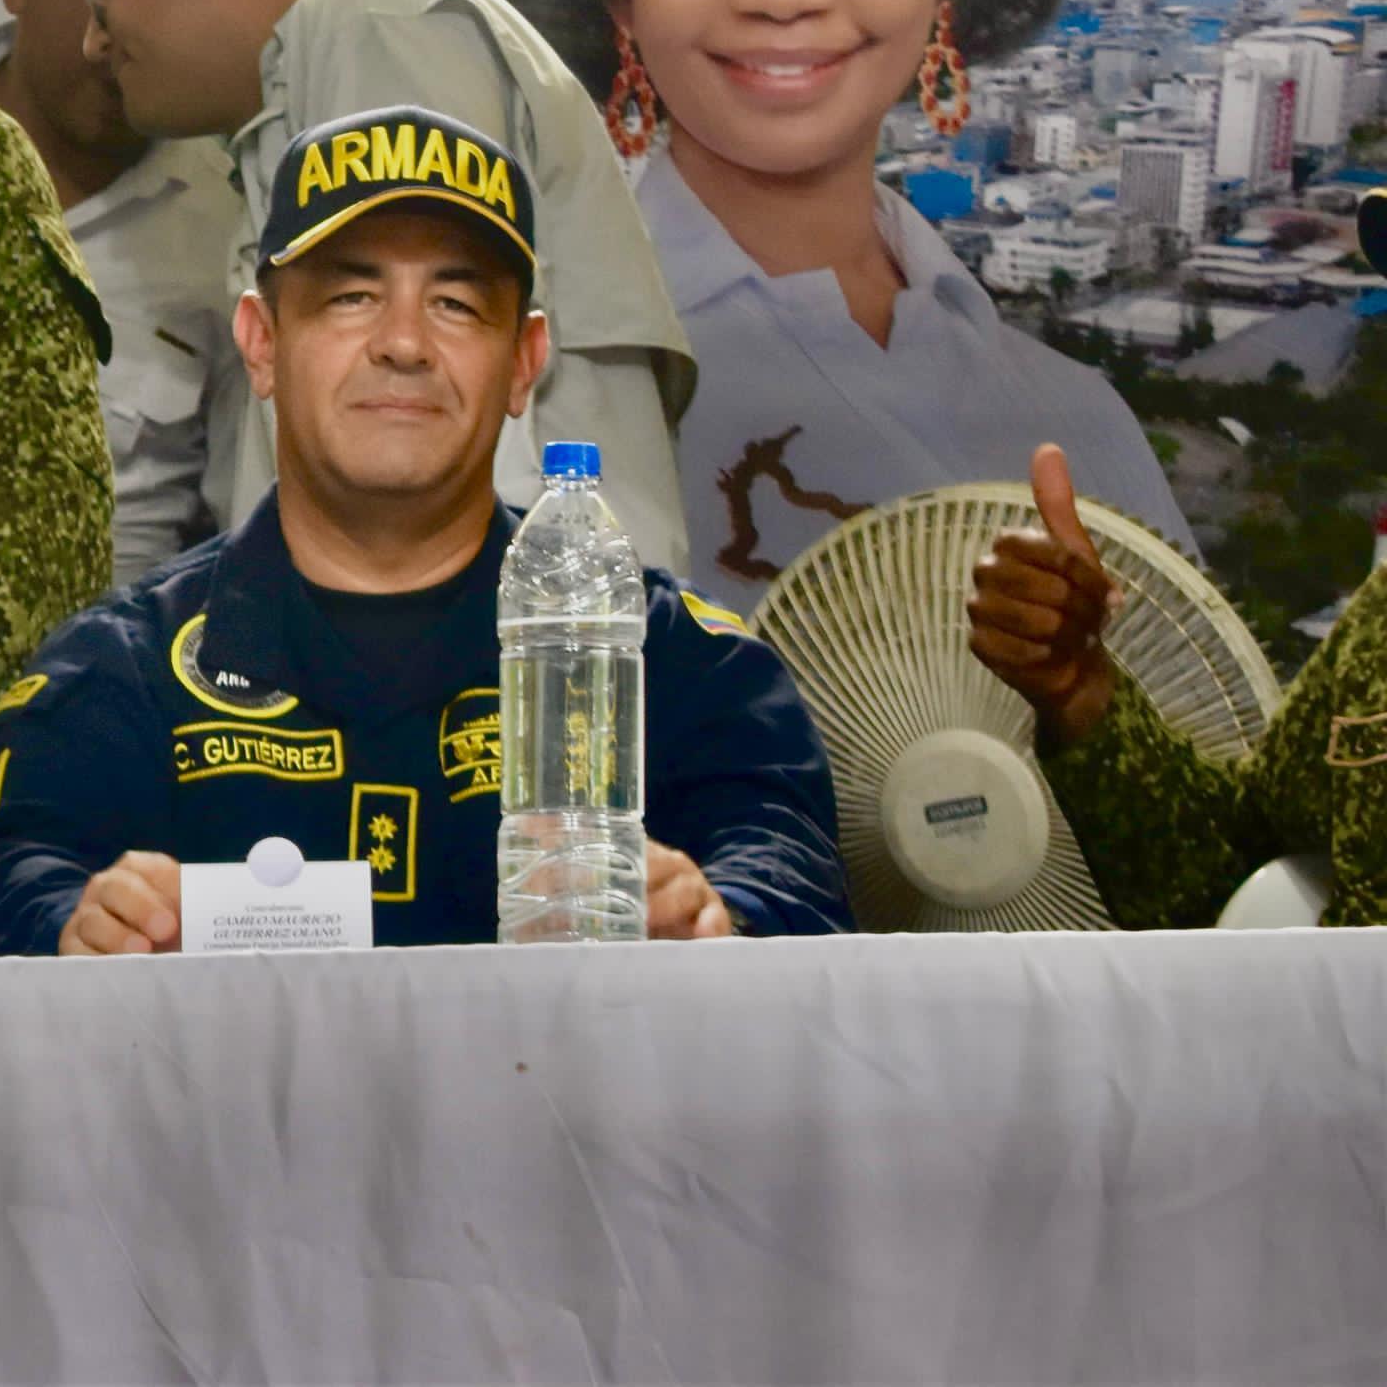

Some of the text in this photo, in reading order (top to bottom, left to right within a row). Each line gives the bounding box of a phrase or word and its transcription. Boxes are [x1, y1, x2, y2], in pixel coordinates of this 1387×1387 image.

[297, 123, 516, 223] ARMADA
[173, 735, 334, 771] C. GUTIÉRREZ
